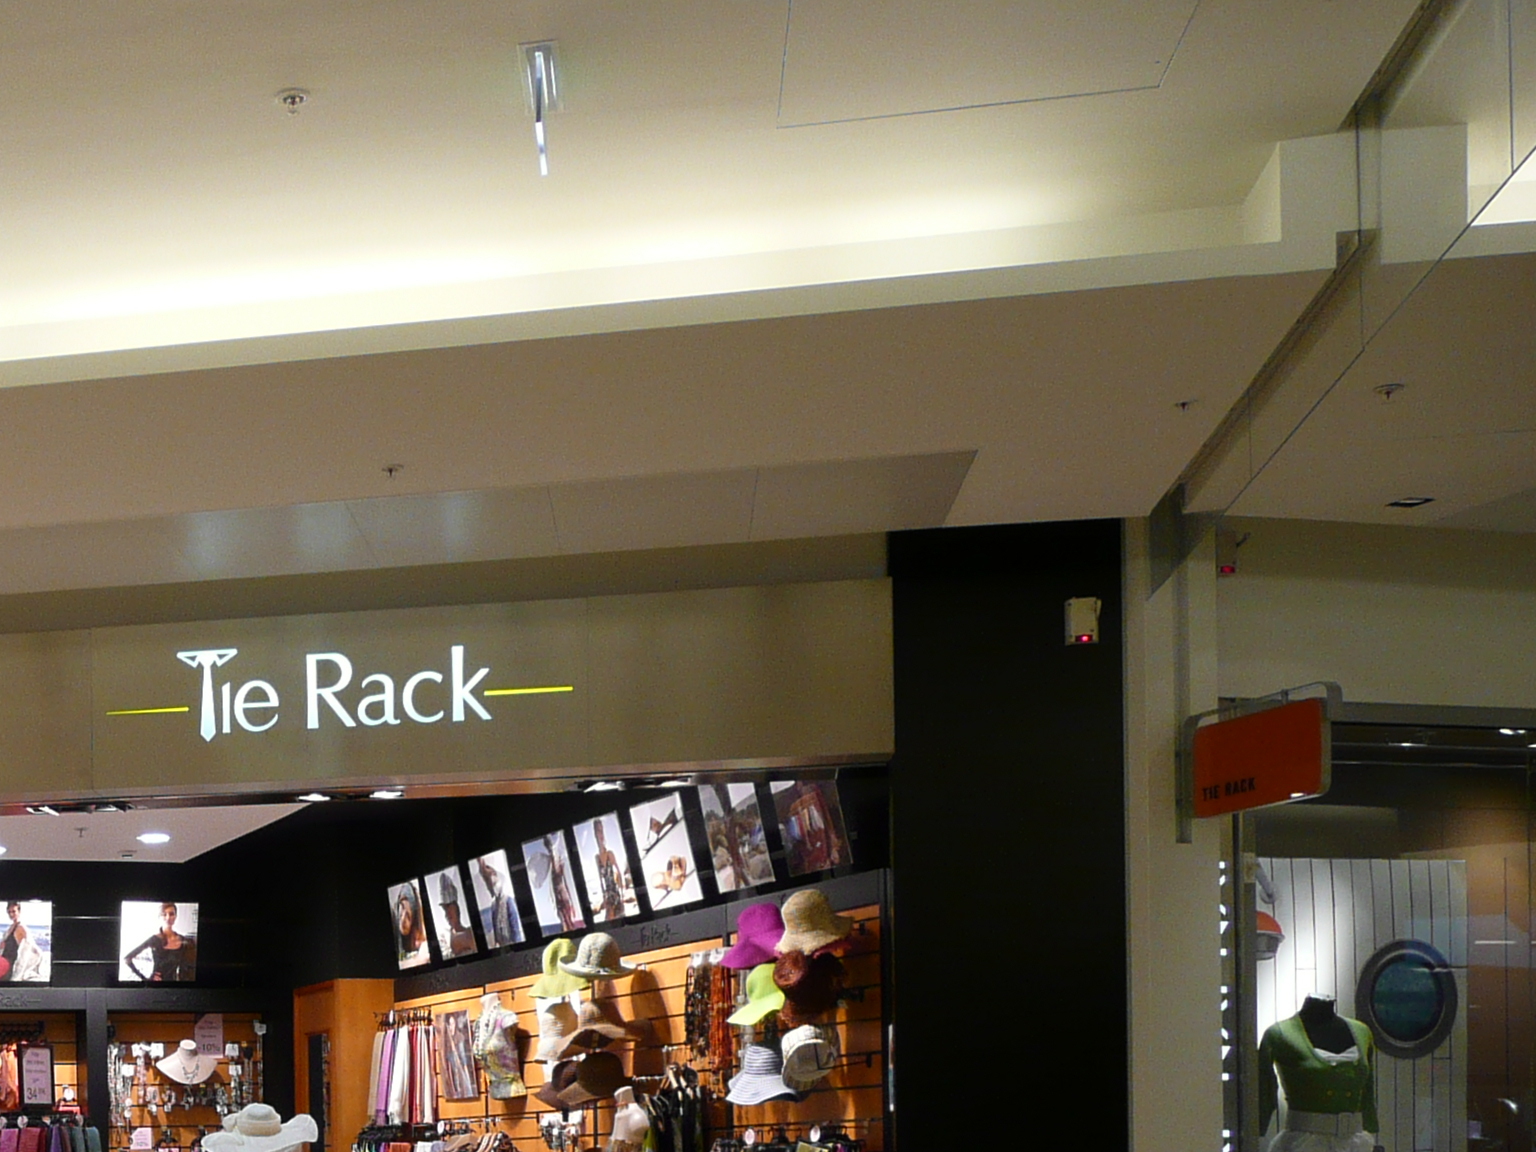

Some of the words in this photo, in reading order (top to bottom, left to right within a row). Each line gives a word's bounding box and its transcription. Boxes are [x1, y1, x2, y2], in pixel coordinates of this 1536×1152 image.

[176, 648, 280, 743] Tie
[306, 645, 493, 730] Rack
[1202, 784, 1221, 801] TIE
[1225, 777, 1256, 796] RACK
